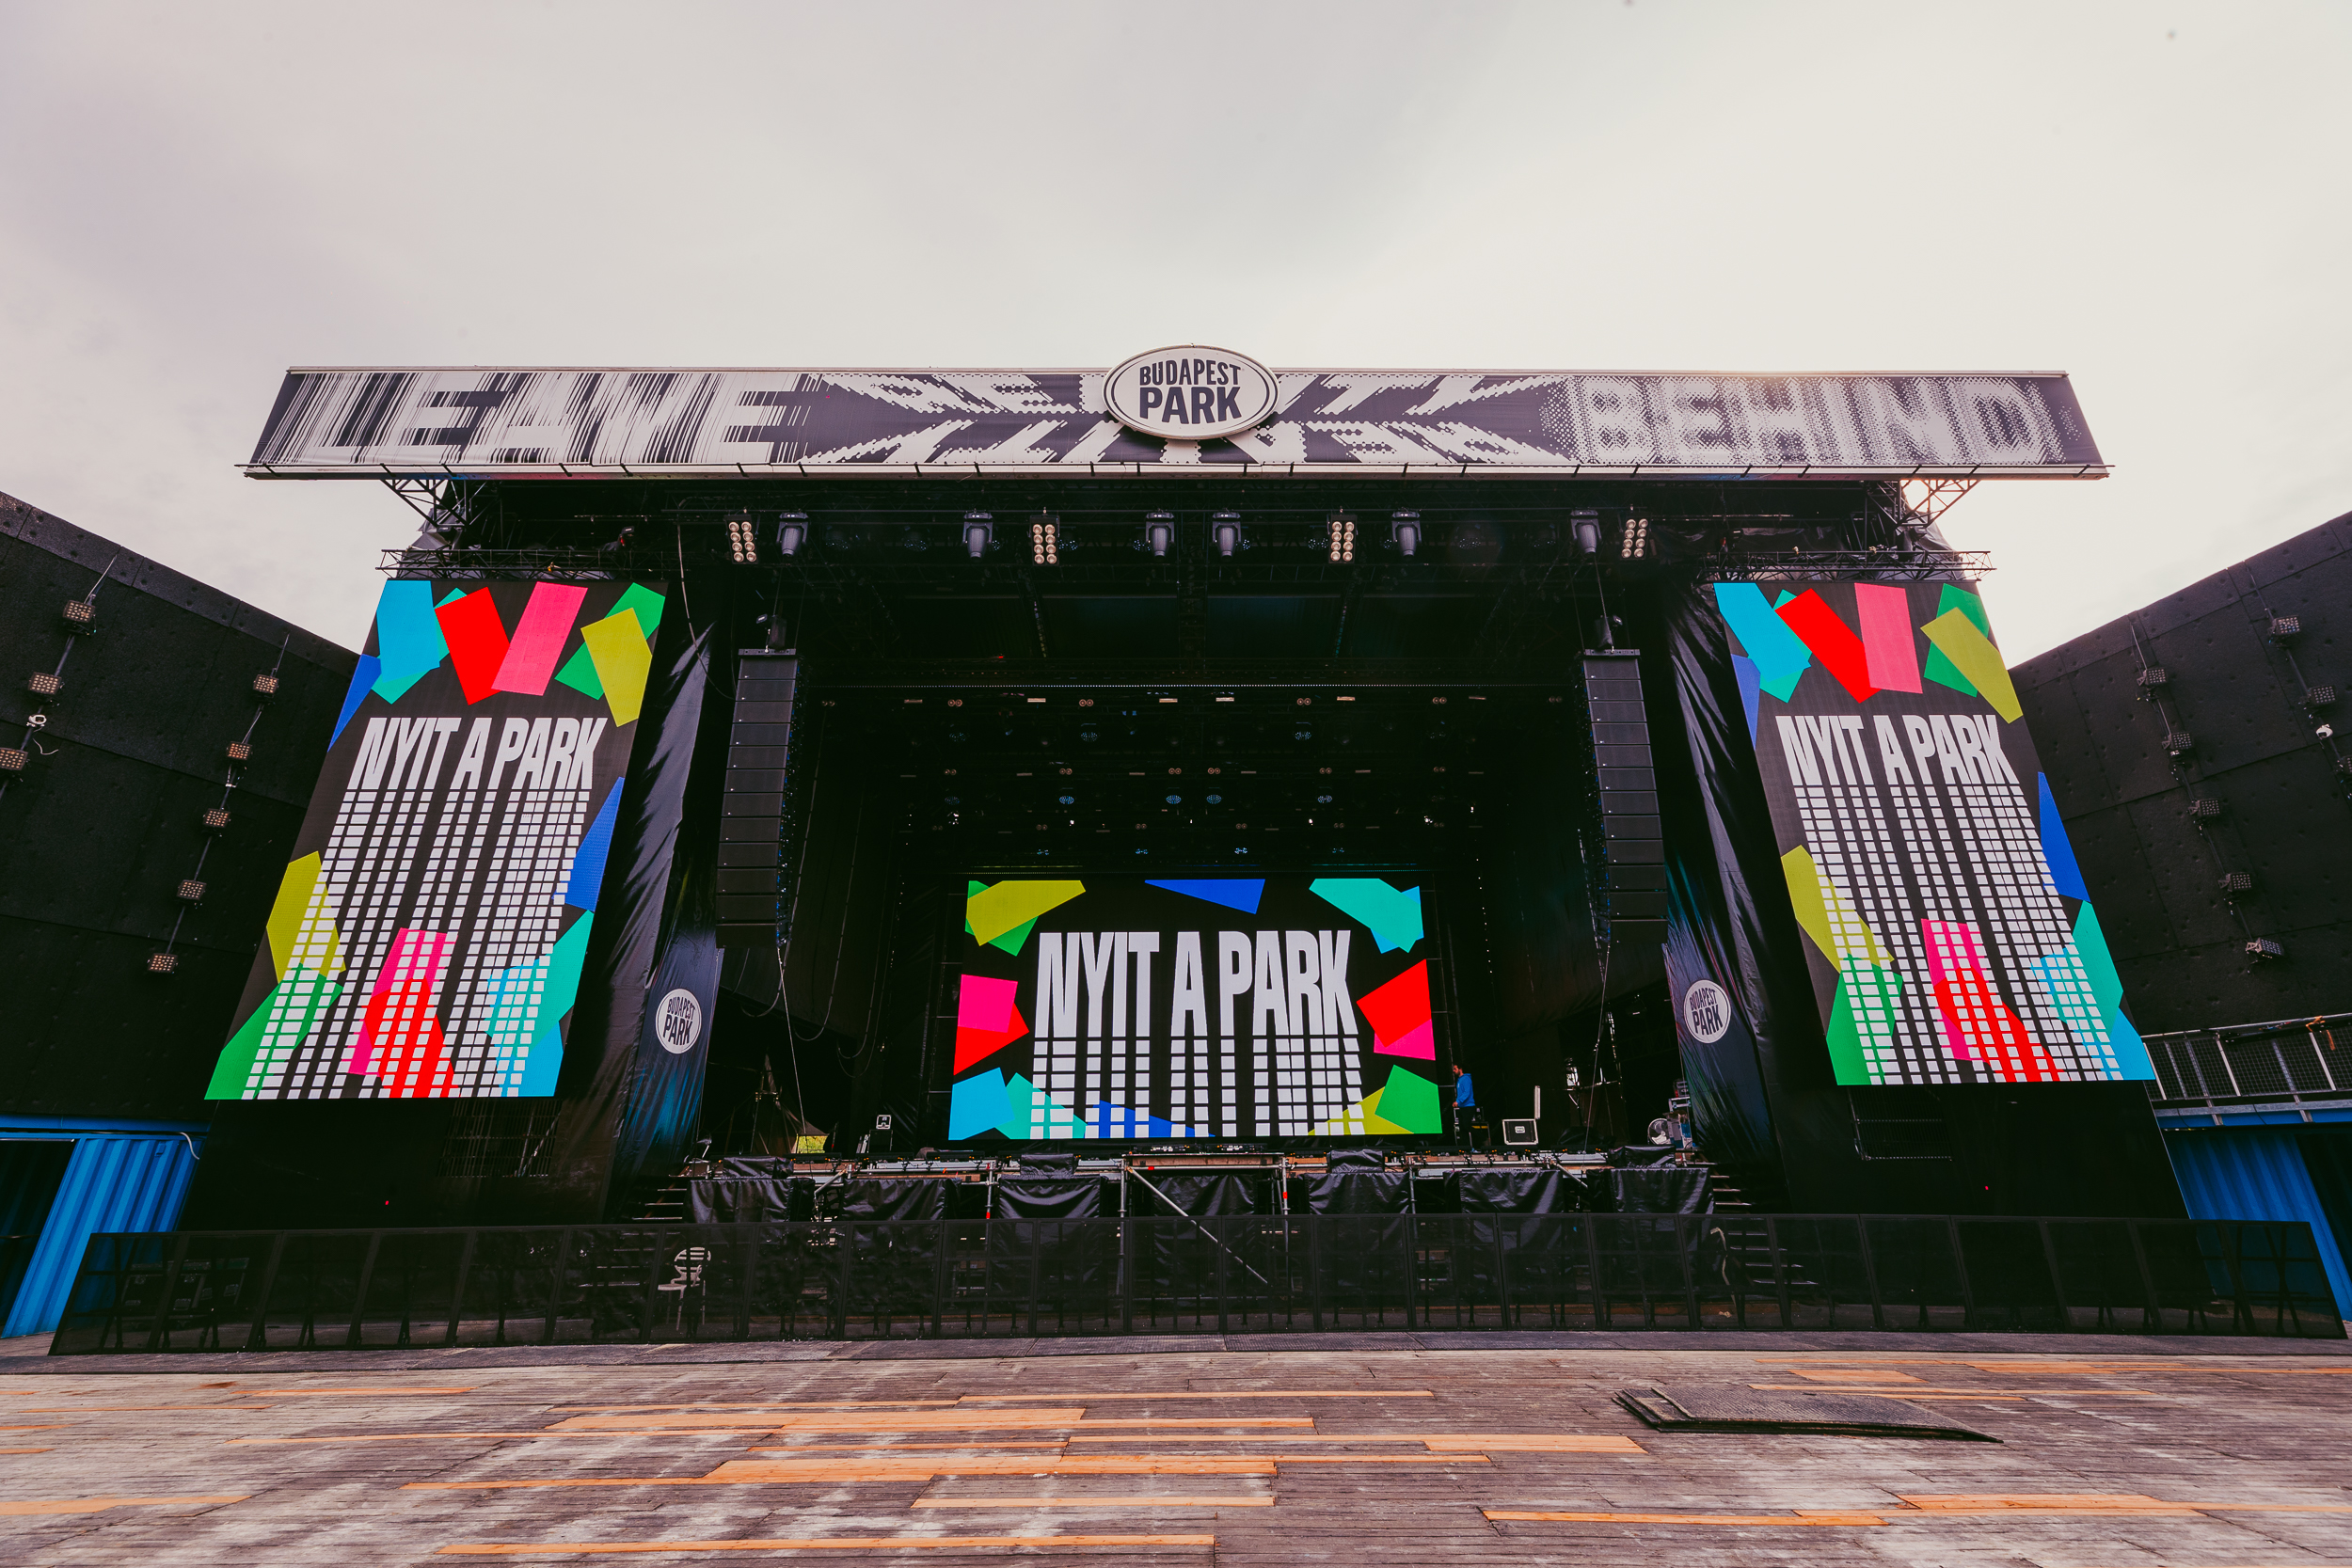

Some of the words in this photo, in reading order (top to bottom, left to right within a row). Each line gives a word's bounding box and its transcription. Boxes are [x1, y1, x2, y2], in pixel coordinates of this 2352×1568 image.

[1139, 358, 1241, 386] BUDAPEST
[256, 372, 800, 464] LEAVE
[1571, 374, 2063, 465] BEHIND
[1139, 387, 1243, 424] PARK
[346, 717, 462, 790] NYIT
[450, 717, 493, 790] A
[487, 717, 609, 790] PARK
[1775, 715, 1875, 786] NYIT
[1873, 715, 1915, 785] A
[1901, 714, 2020, 784] PARK
[1034, 931, 1160, 1038] NYIT
[1170, 931, 1208, 1037] A
[1218, 929, 1359, 1037] PARK
[1689, 988, 1718, 1011] BUDAPEST
[666, 996, 696, 1021] BUDAPEST
[1692, 1005, 1723, 1036] PARK
[662, 1013, 692, 1046] PARK
